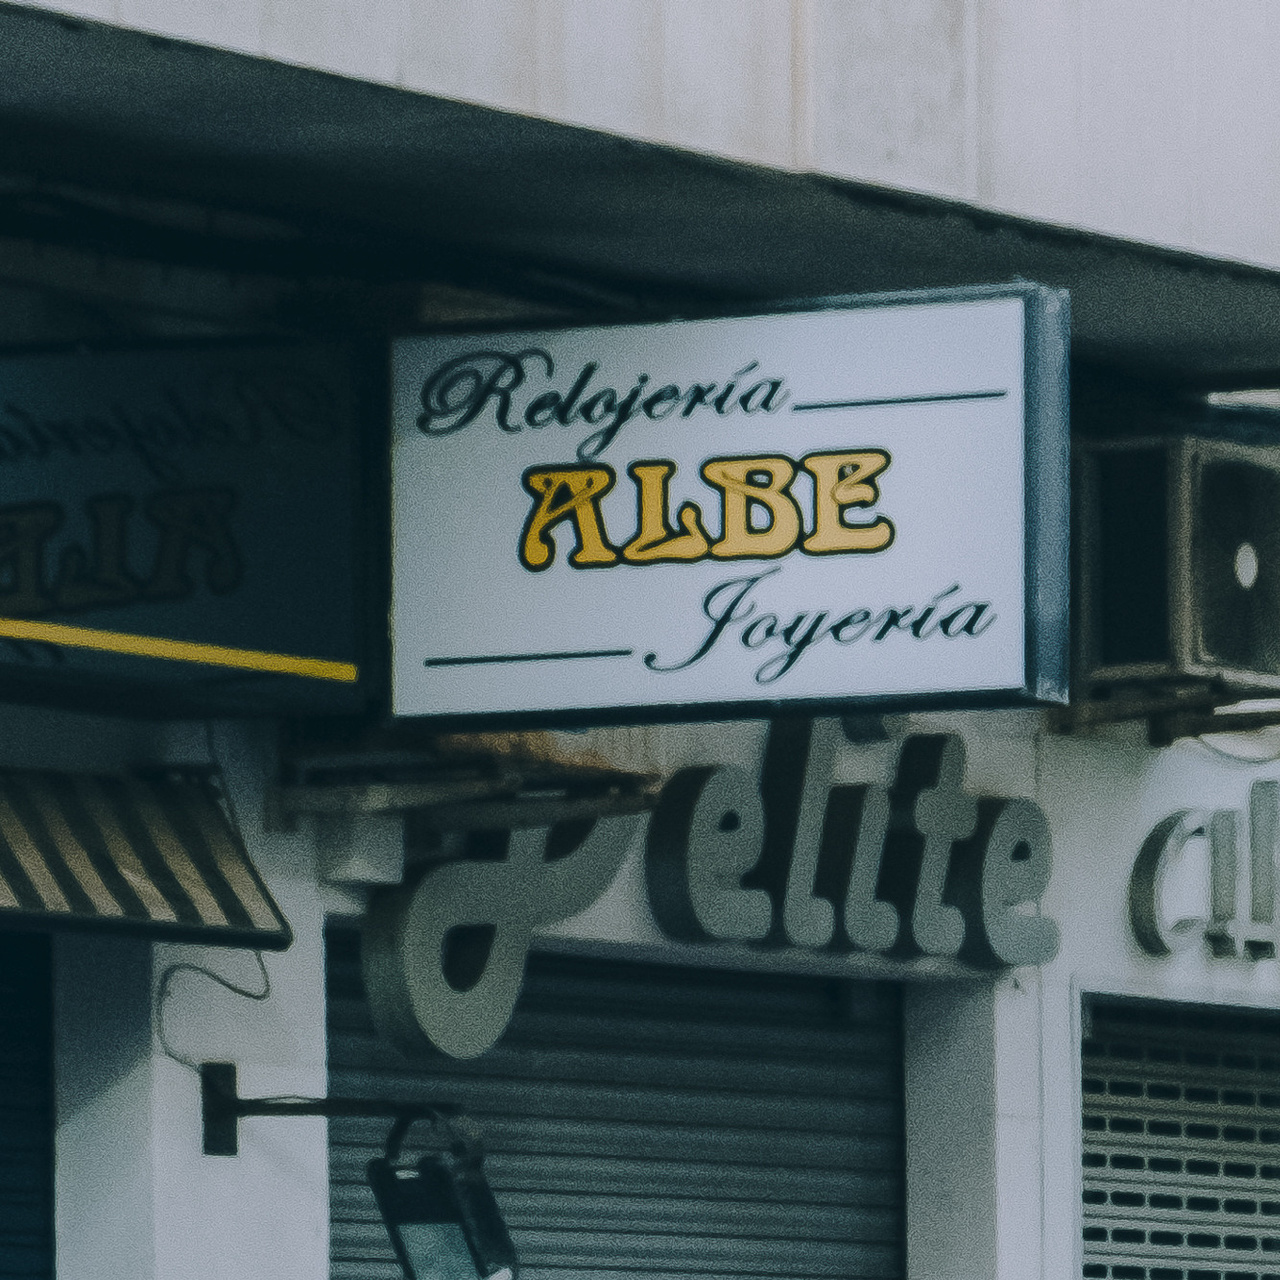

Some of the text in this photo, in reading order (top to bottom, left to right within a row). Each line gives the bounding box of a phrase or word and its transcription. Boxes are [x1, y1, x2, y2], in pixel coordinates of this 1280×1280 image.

[416, 348, 789, 463] Relojería
[518, 447, 895, 572] ALBE
[642, 566, 998, 685] Joyería
